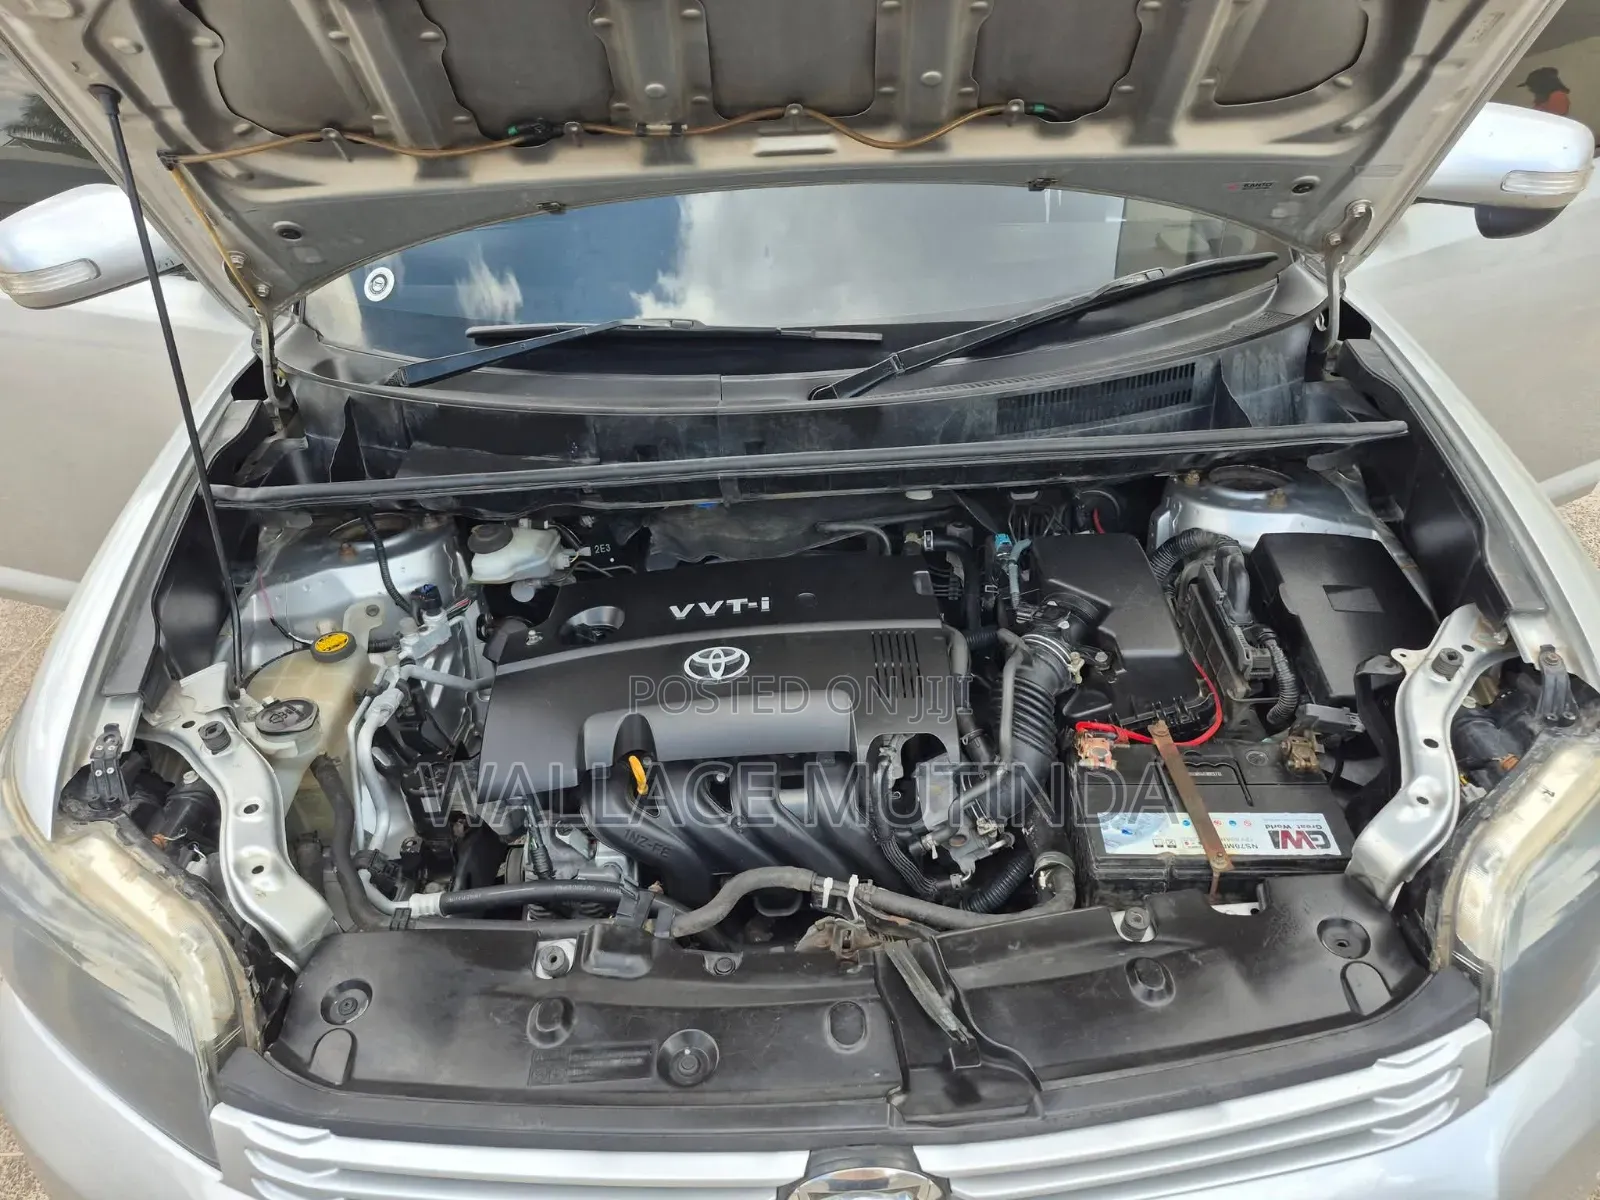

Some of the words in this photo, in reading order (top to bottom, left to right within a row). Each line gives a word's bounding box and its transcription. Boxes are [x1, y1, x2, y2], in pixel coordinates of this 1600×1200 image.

[594, 543, 612, 554] 2E3
[668, 596, 770, 620] VVT-i
[624, 828, 672, 858] 1NZ-FE
